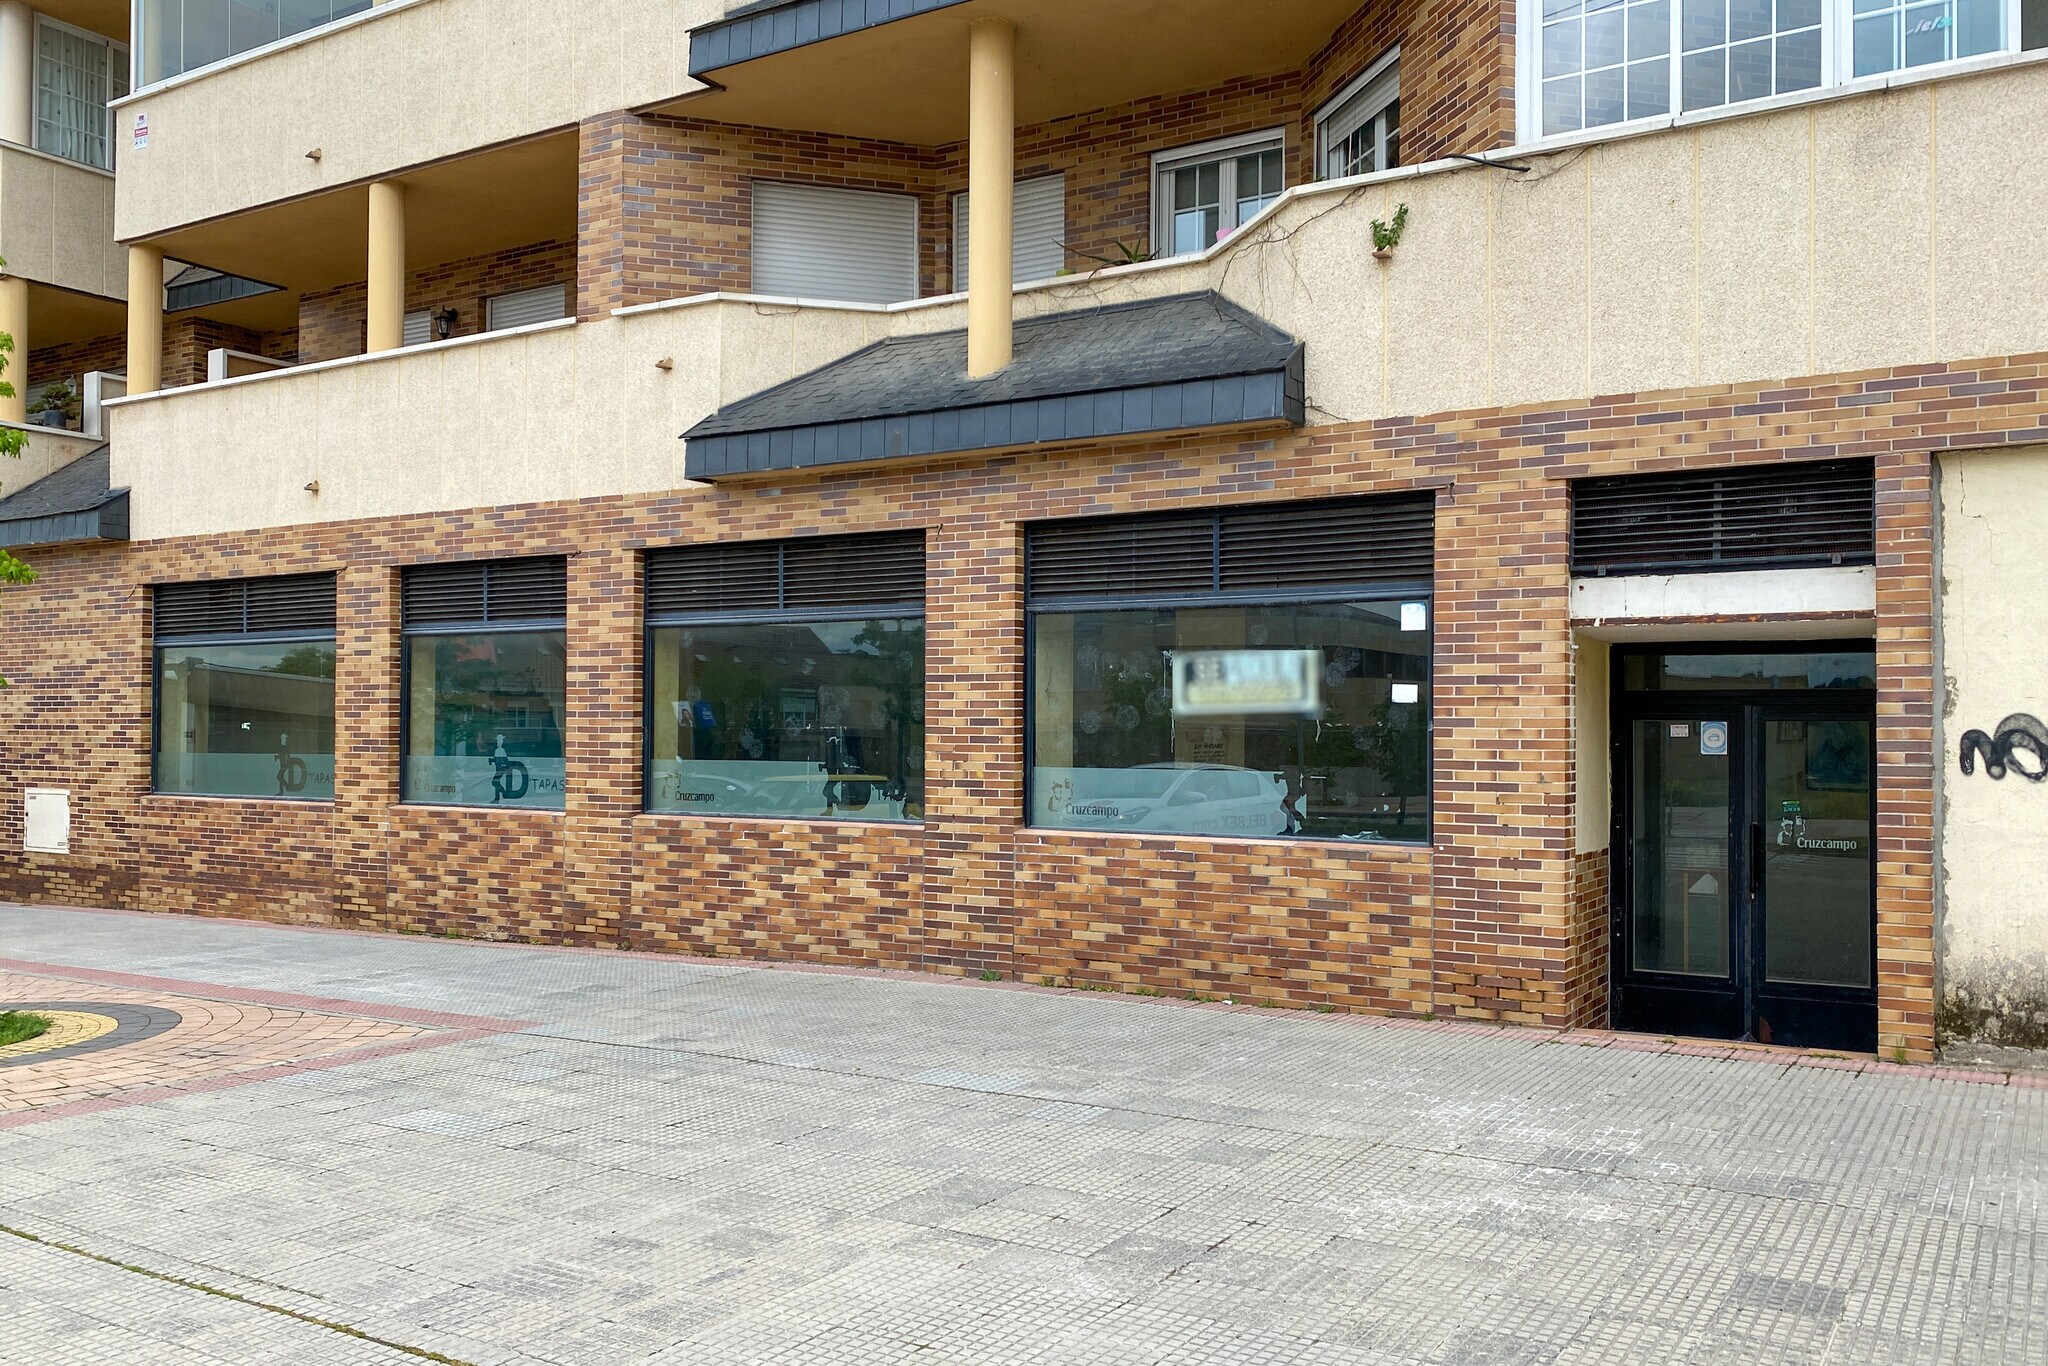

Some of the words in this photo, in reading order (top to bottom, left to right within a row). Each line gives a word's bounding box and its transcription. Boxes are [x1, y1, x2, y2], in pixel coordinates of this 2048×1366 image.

[675, 790, 715, 803] Cruzcampo
[1065, 802, 1119, 818] Cruzcampo
[1796, 837, 1857, 852] Cruzcampo
